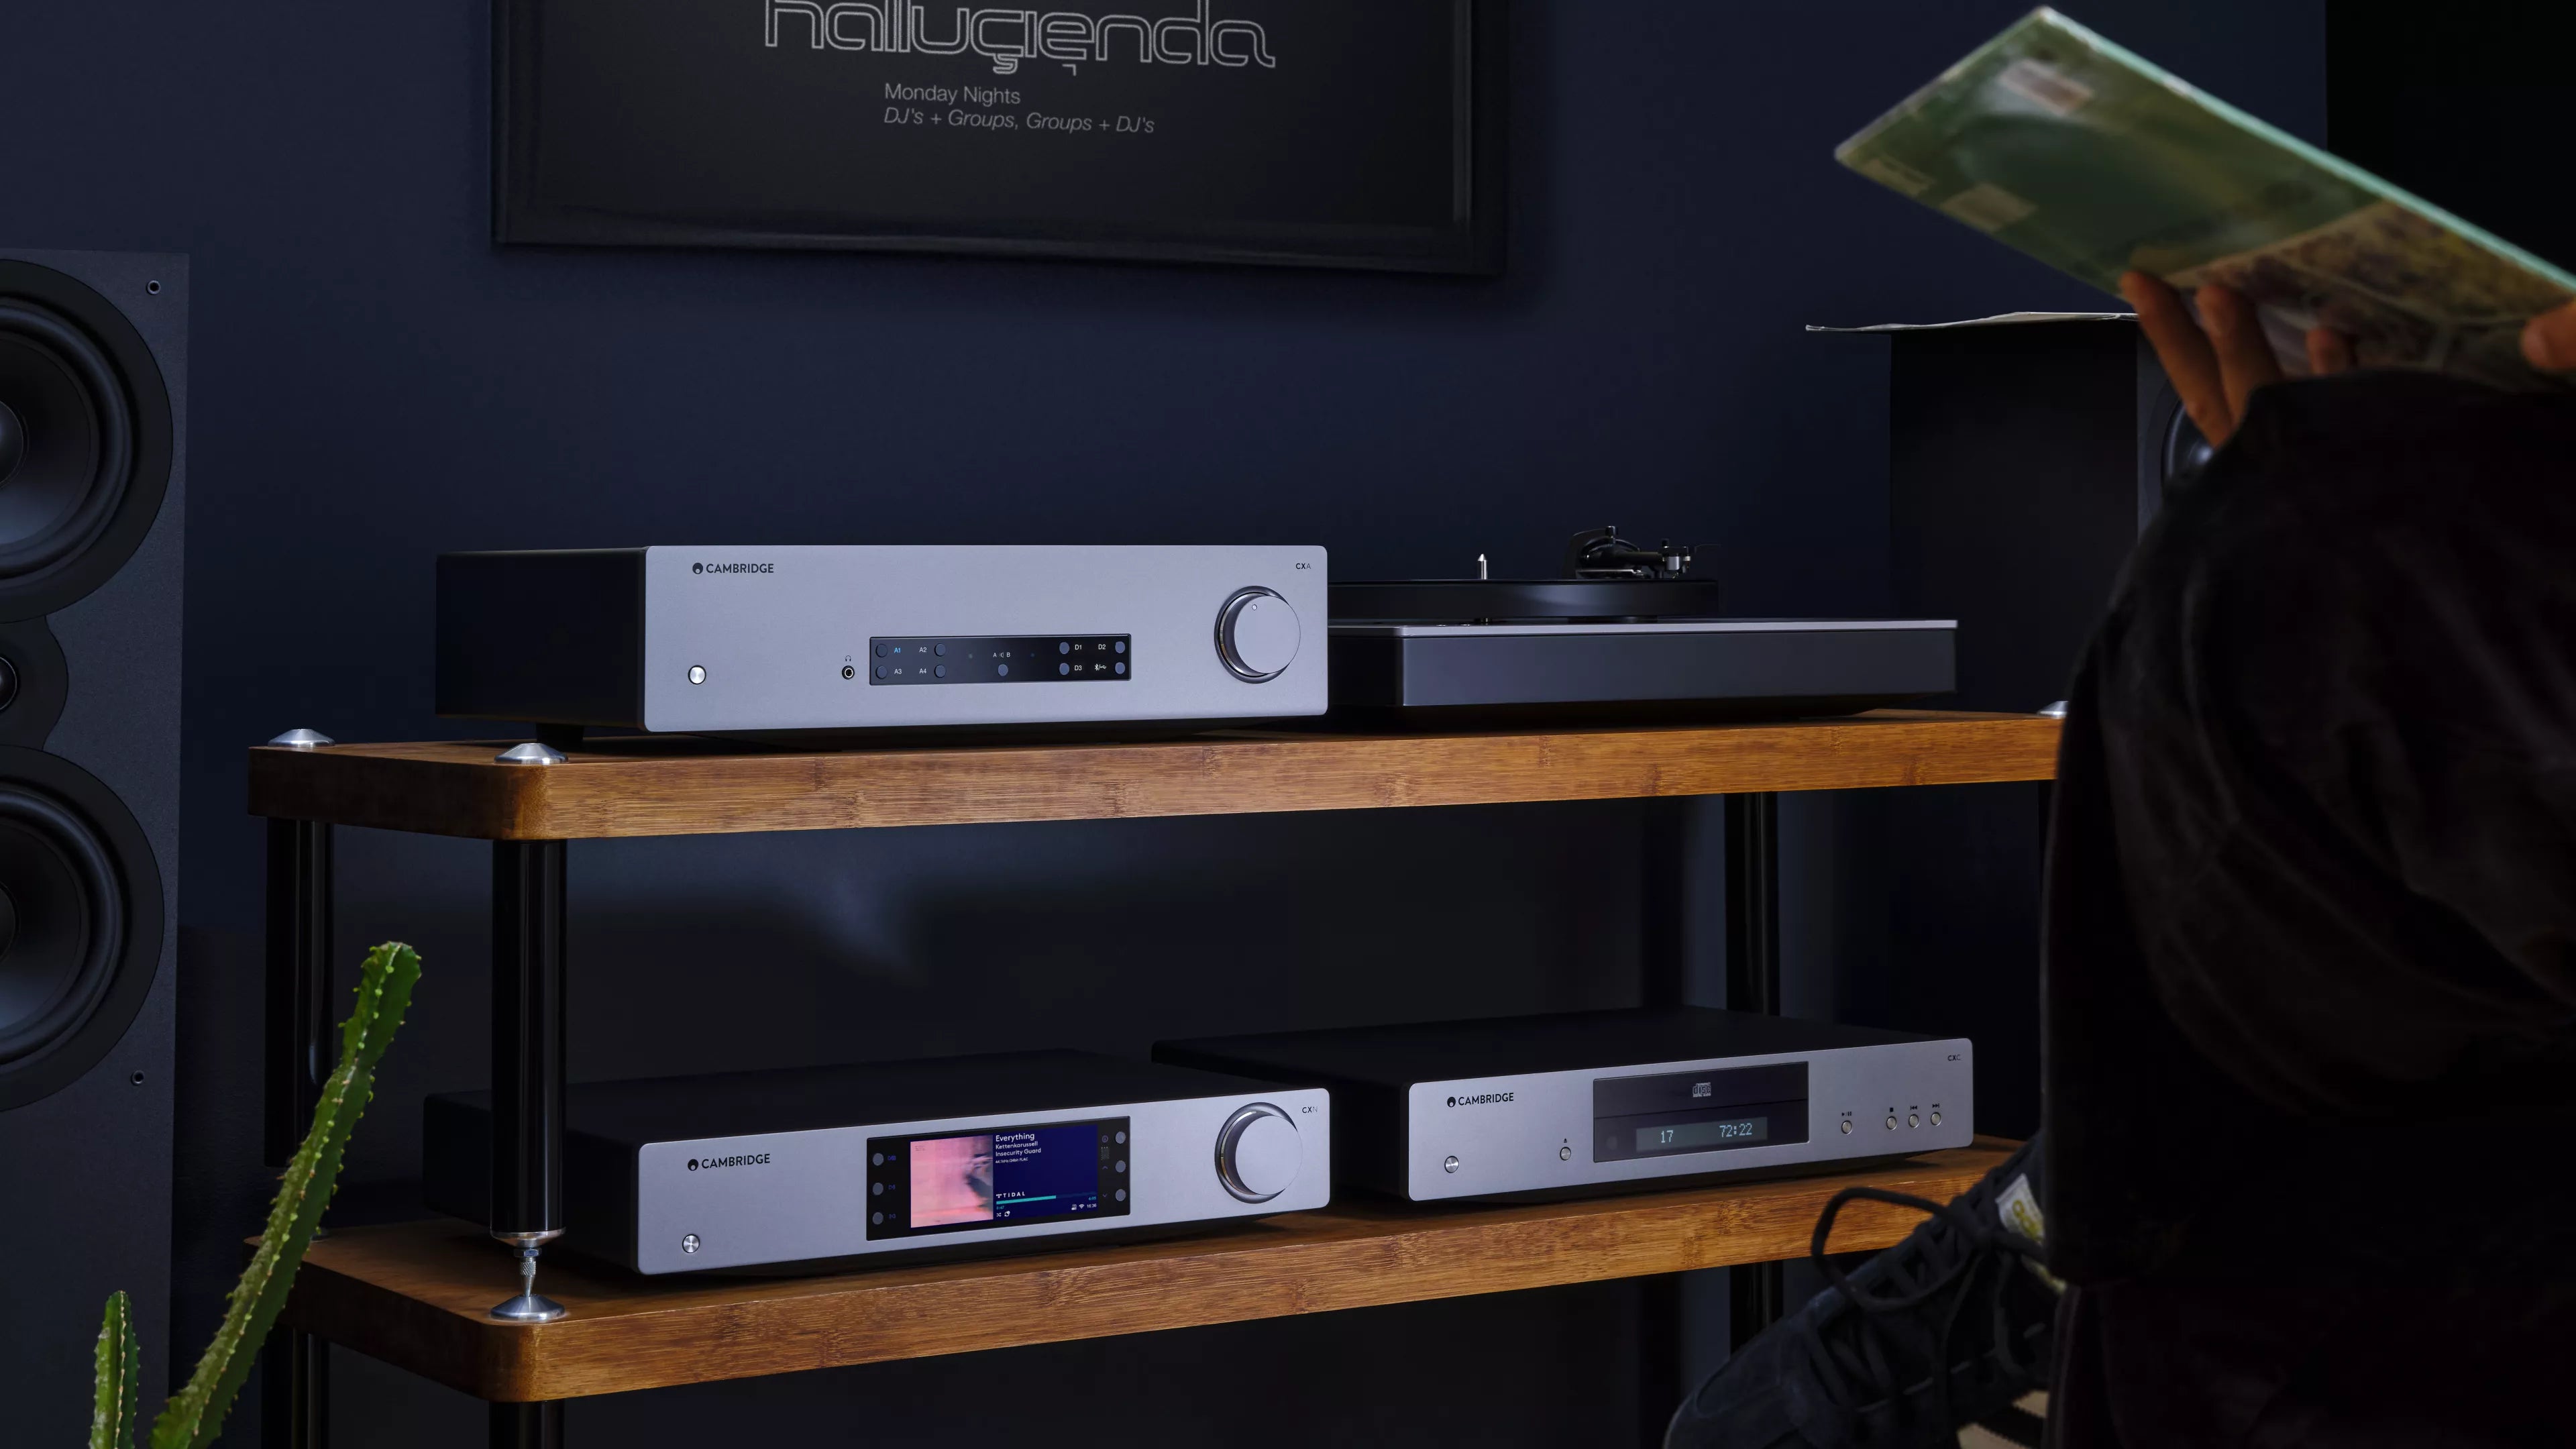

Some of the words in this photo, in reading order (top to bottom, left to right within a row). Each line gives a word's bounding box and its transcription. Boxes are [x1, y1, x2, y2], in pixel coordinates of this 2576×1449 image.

[885, 83, 958, 105] Monday
[964, 86, 1020, 107] Nights
[884, 107, 924, 125] DJ's
[948, 109, 1018, 131] Groups,
[1026, 112, 1093, 134] Groups
[1116, 115, 1155, 133] DJ's
[706, 563, 774, 574] CAMBRIDGE
[1458, 1092, 1514, 1106] CAMBRIDGE
[996, 1133, 1035, 1142] Everything
[1661, 1130, 1674, 1143] 17
[1719, 1123, 1753, 1138] 72:22
[996, 1141, 1038, 1150] Kettenkarussell
[701, 1153, 771, 1169] CAMBRIDGE
